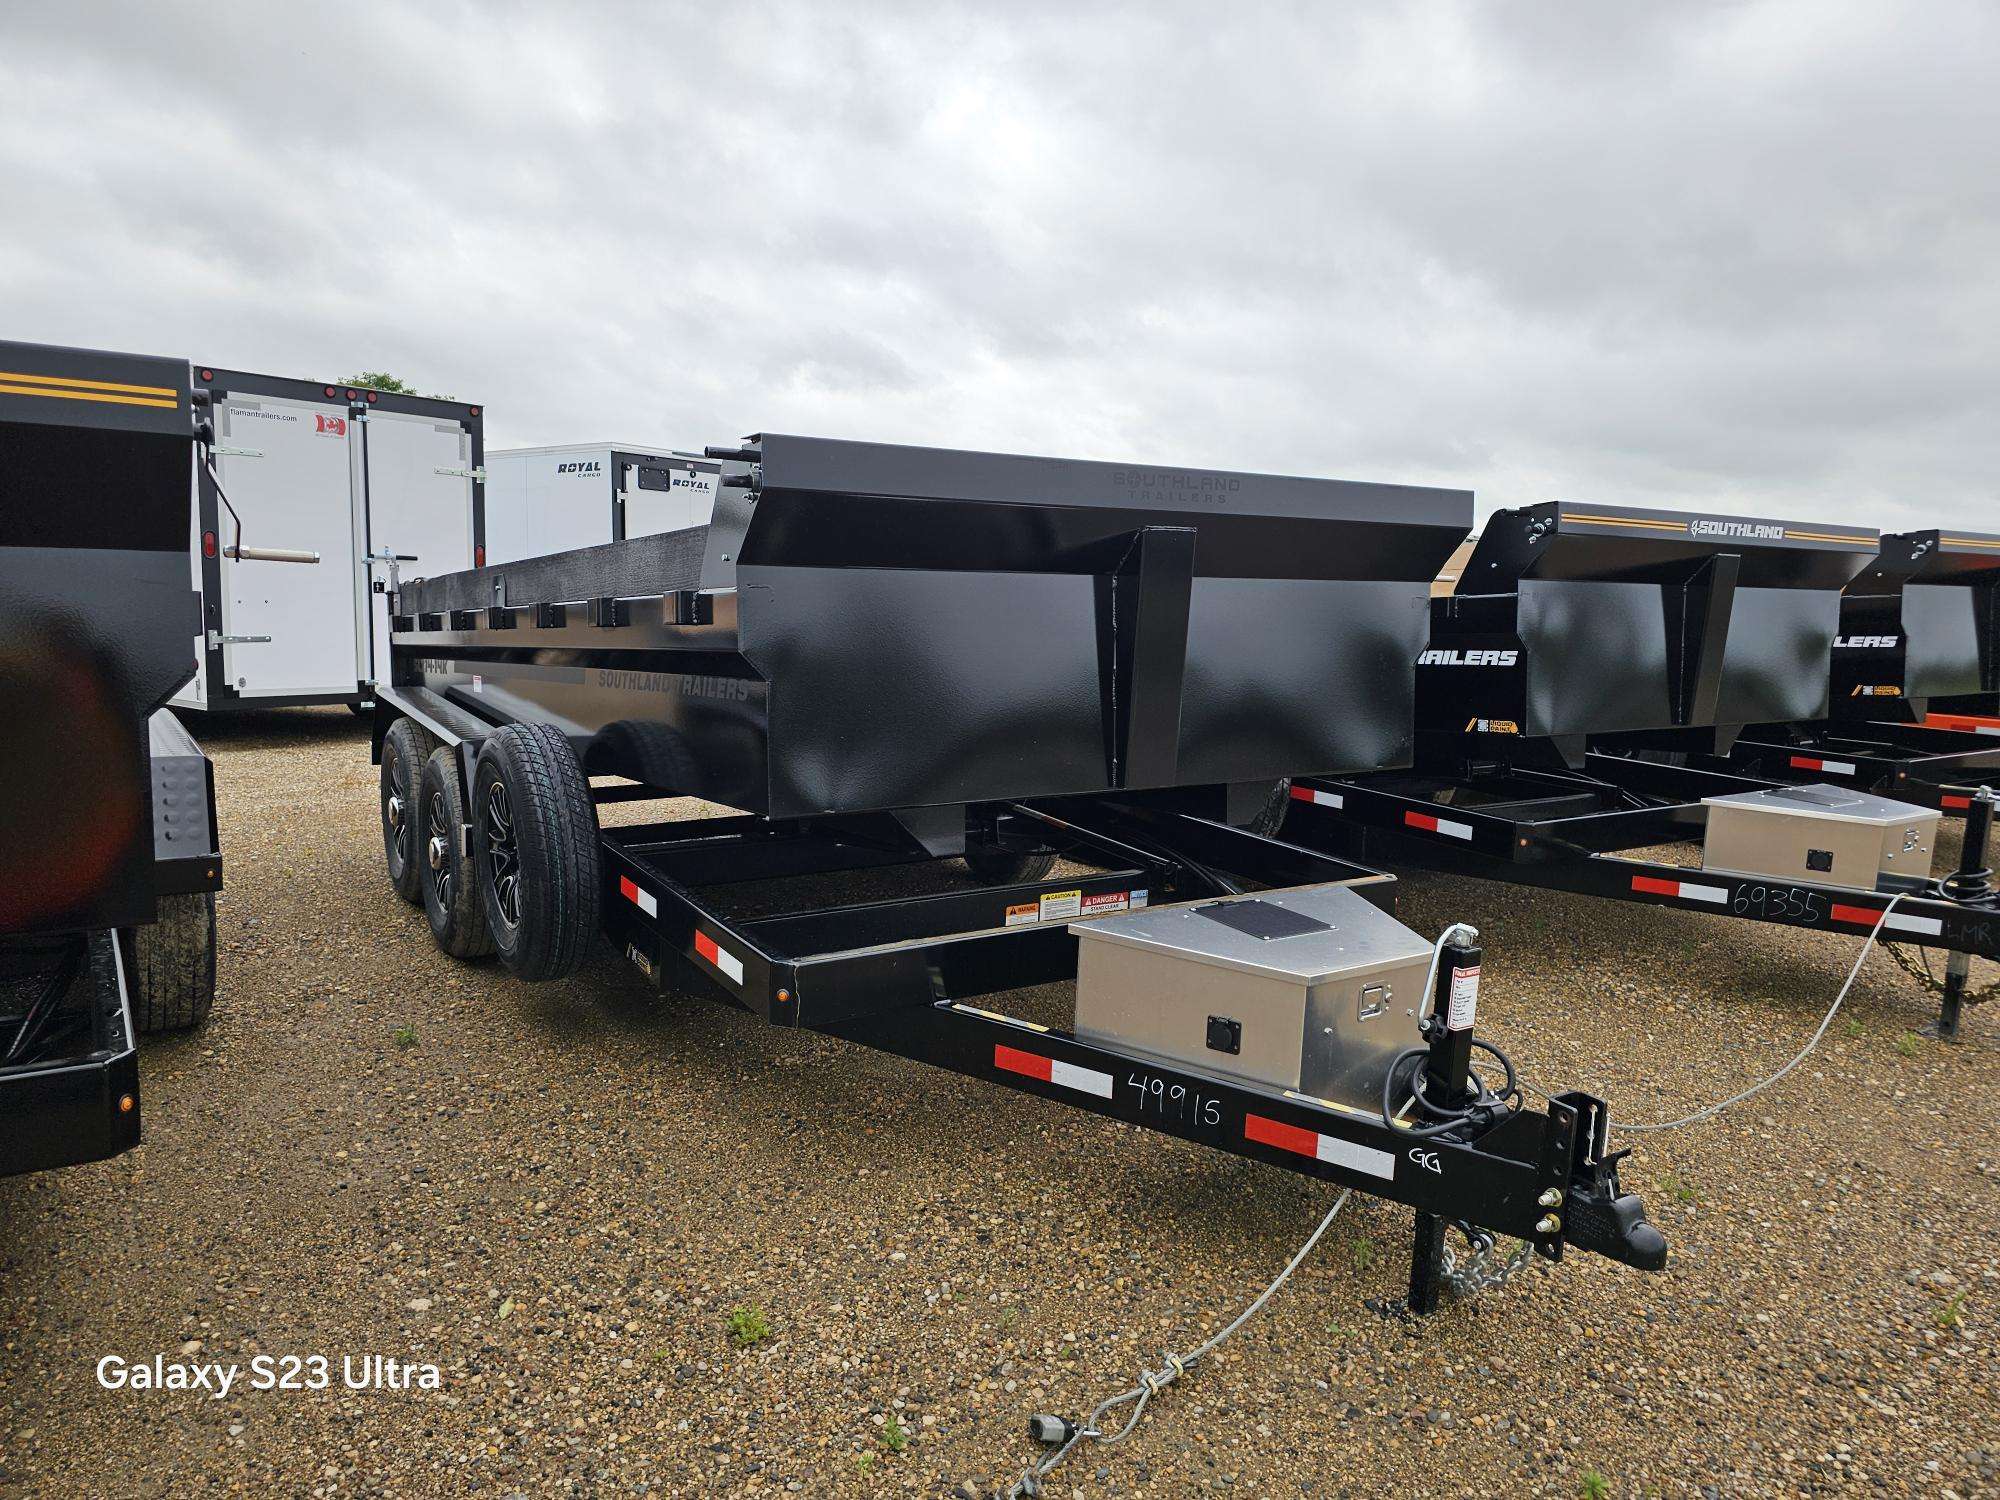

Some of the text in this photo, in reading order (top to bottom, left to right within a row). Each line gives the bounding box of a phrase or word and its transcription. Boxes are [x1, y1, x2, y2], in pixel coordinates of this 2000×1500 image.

[558, 462, 601, 474] ROYAL
[672, 479, 710, 490] ROYAL
[1112, 470, 1241, 492] SOUTHLAND
[1127, 490, 1226, 504] TRAILERS
[1697, 520, 1784, 539] SOUTHLAND
[598, 670, 749, 701] SOUTHLAND TRAILERS
[1051, 892, 1071, 900] CAUTION
[1092, 895, 1118, 905] DANGER
[1734, 883, 1827, 922] 69355
[1127, 1072, 1220, 1126] 49915
